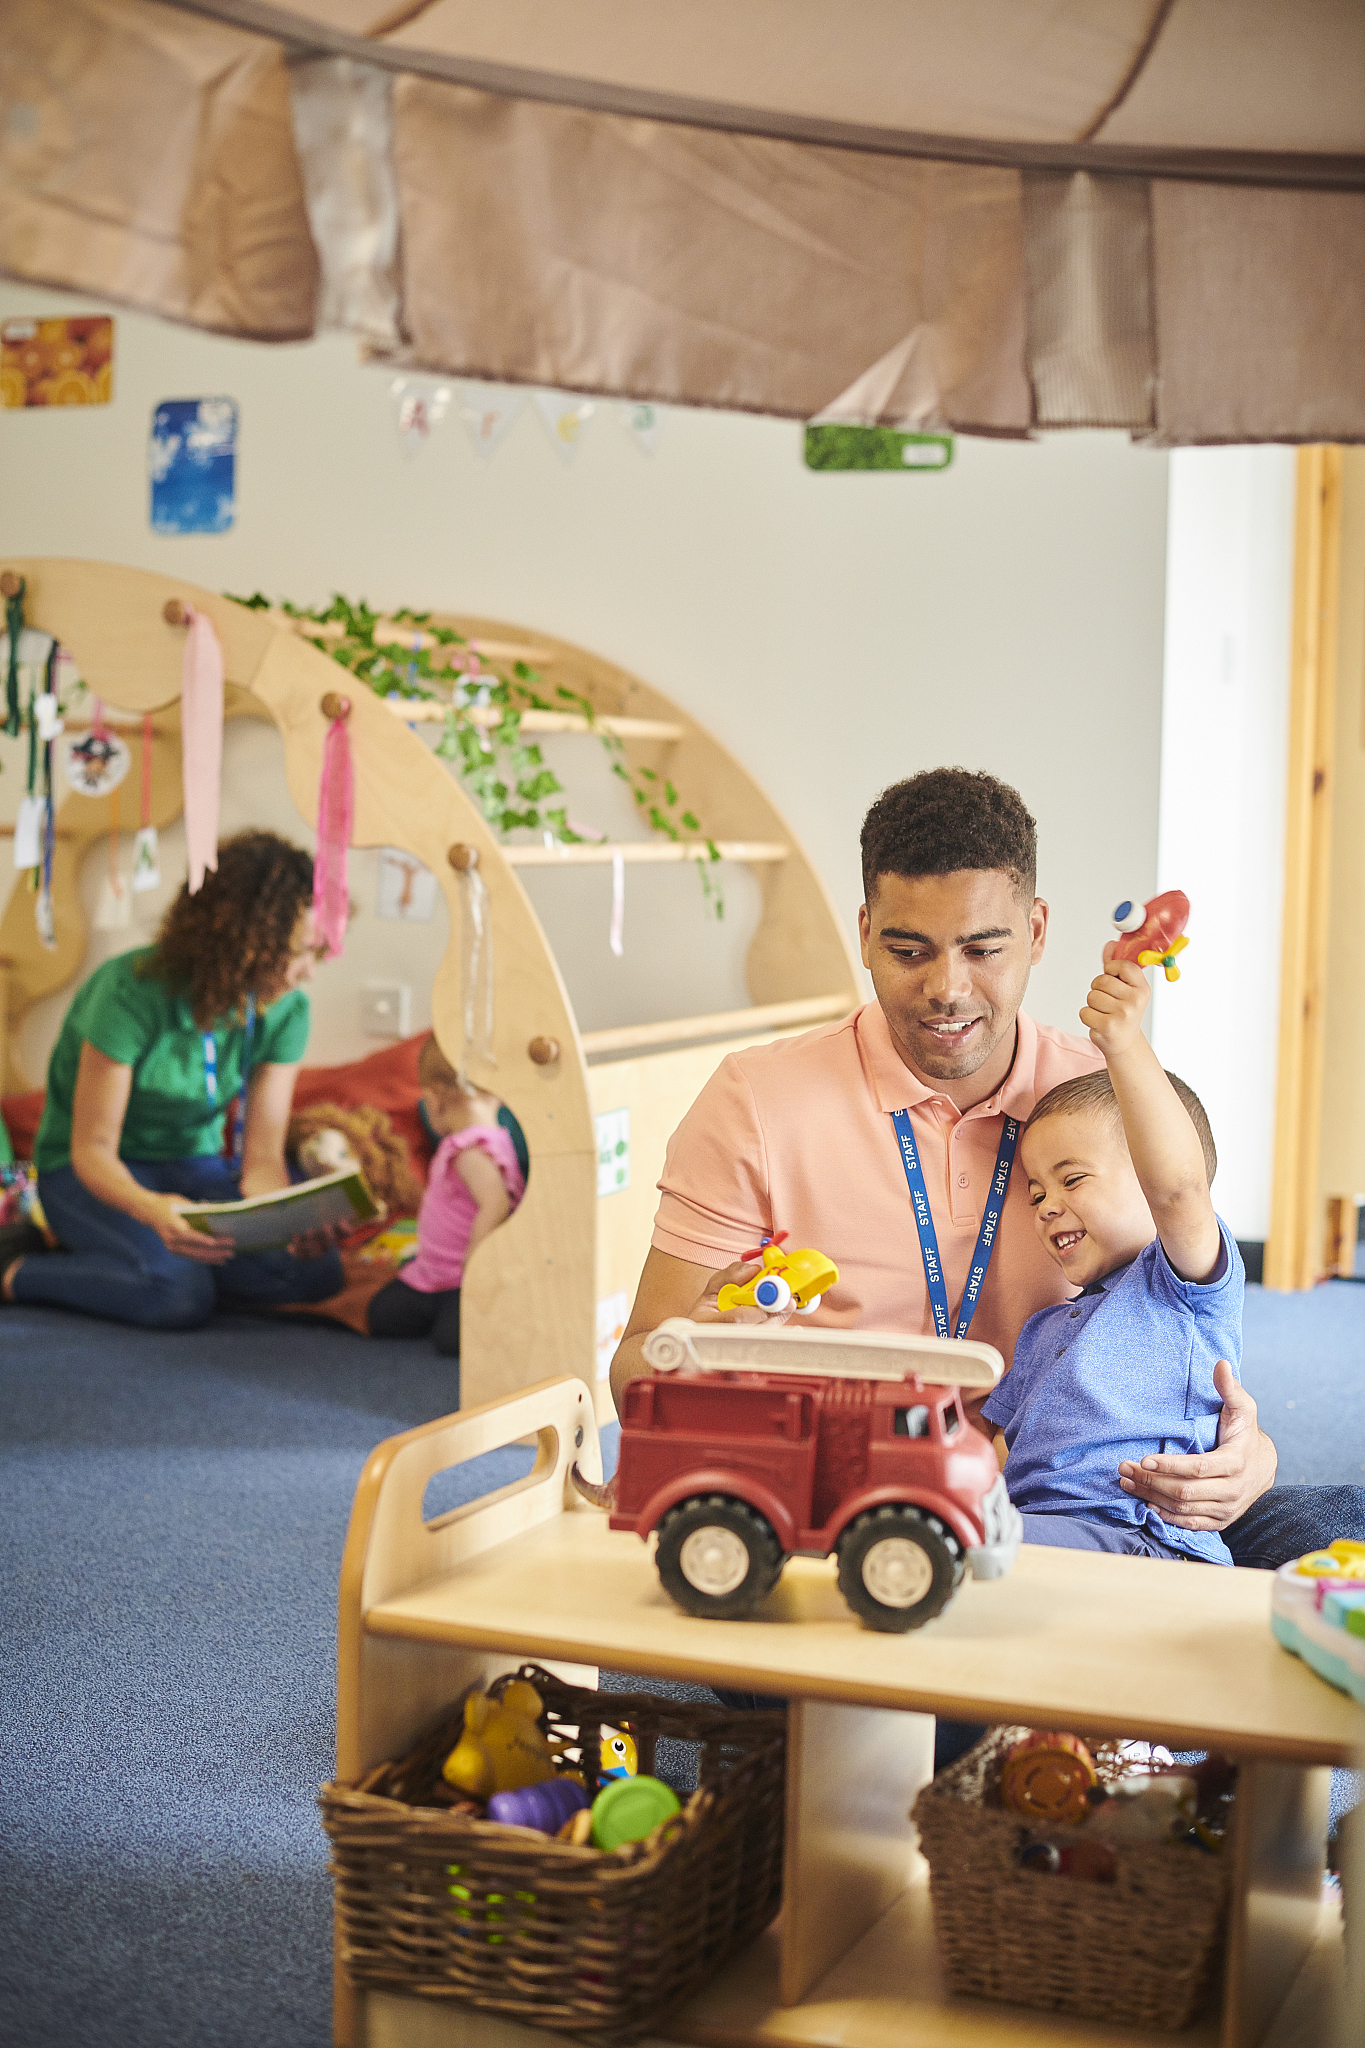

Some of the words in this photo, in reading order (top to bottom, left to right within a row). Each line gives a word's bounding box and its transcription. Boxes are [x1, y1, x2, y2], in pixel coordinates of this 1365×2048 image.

[1006, 1118, 1017, 1141] AFF
[901, 1134, 917, 1169] STAFF
[994, 1160, 1009, 1195] STAFF
[914, 1190, 929, 1225] STAFF
[982, 1211, 998, 1246] STAFF
[925, 1247, 940, 1282] STAFF
[967, 1266, 983, 1301] STAFF
[956, 1321, 967, 1340] STA
